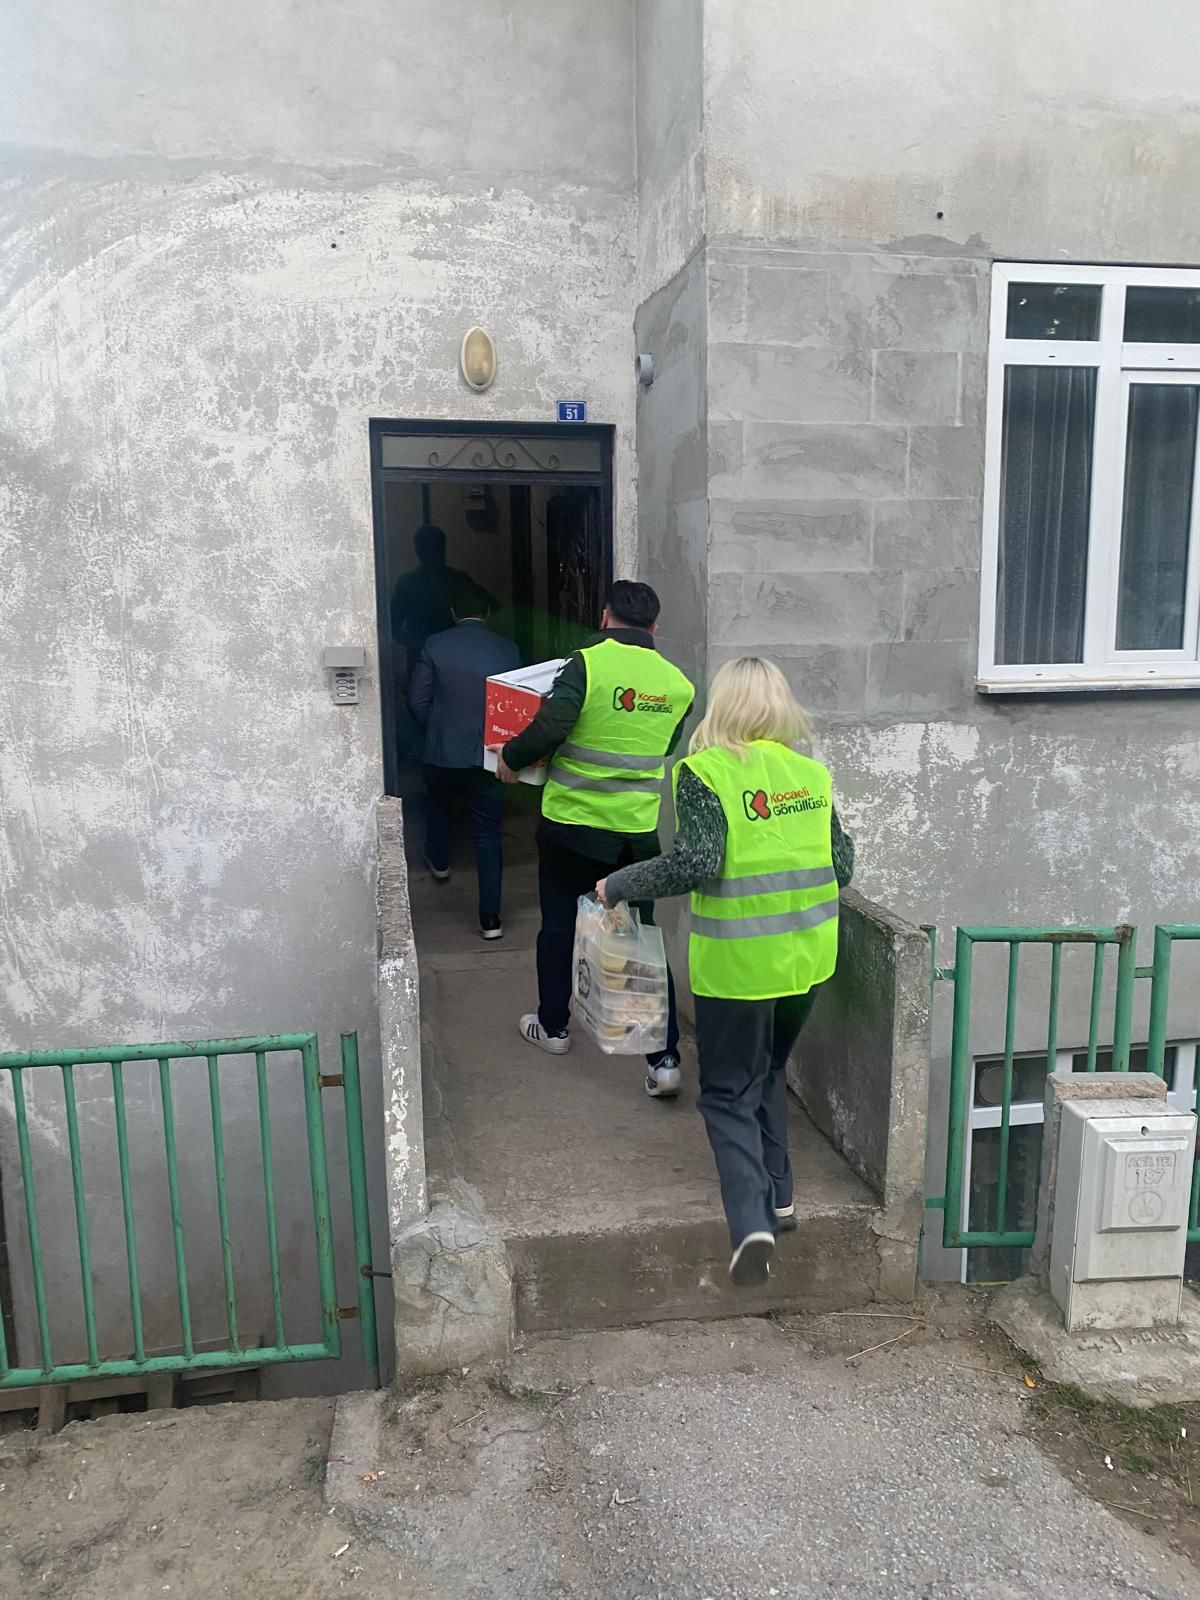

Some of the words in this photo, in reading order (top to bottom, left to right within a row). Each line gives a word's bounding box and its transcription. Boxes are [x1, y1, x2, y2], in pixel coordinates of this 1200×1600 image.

[566, 408, 578, 420] 51
[770, 786, 810, 804] Kocaeli
[772, 795, 828, 816] Gönüllüsü
[1156, 1156, 1173, 1167] TEL
[1135, 1168, 1165, 1185] 187
